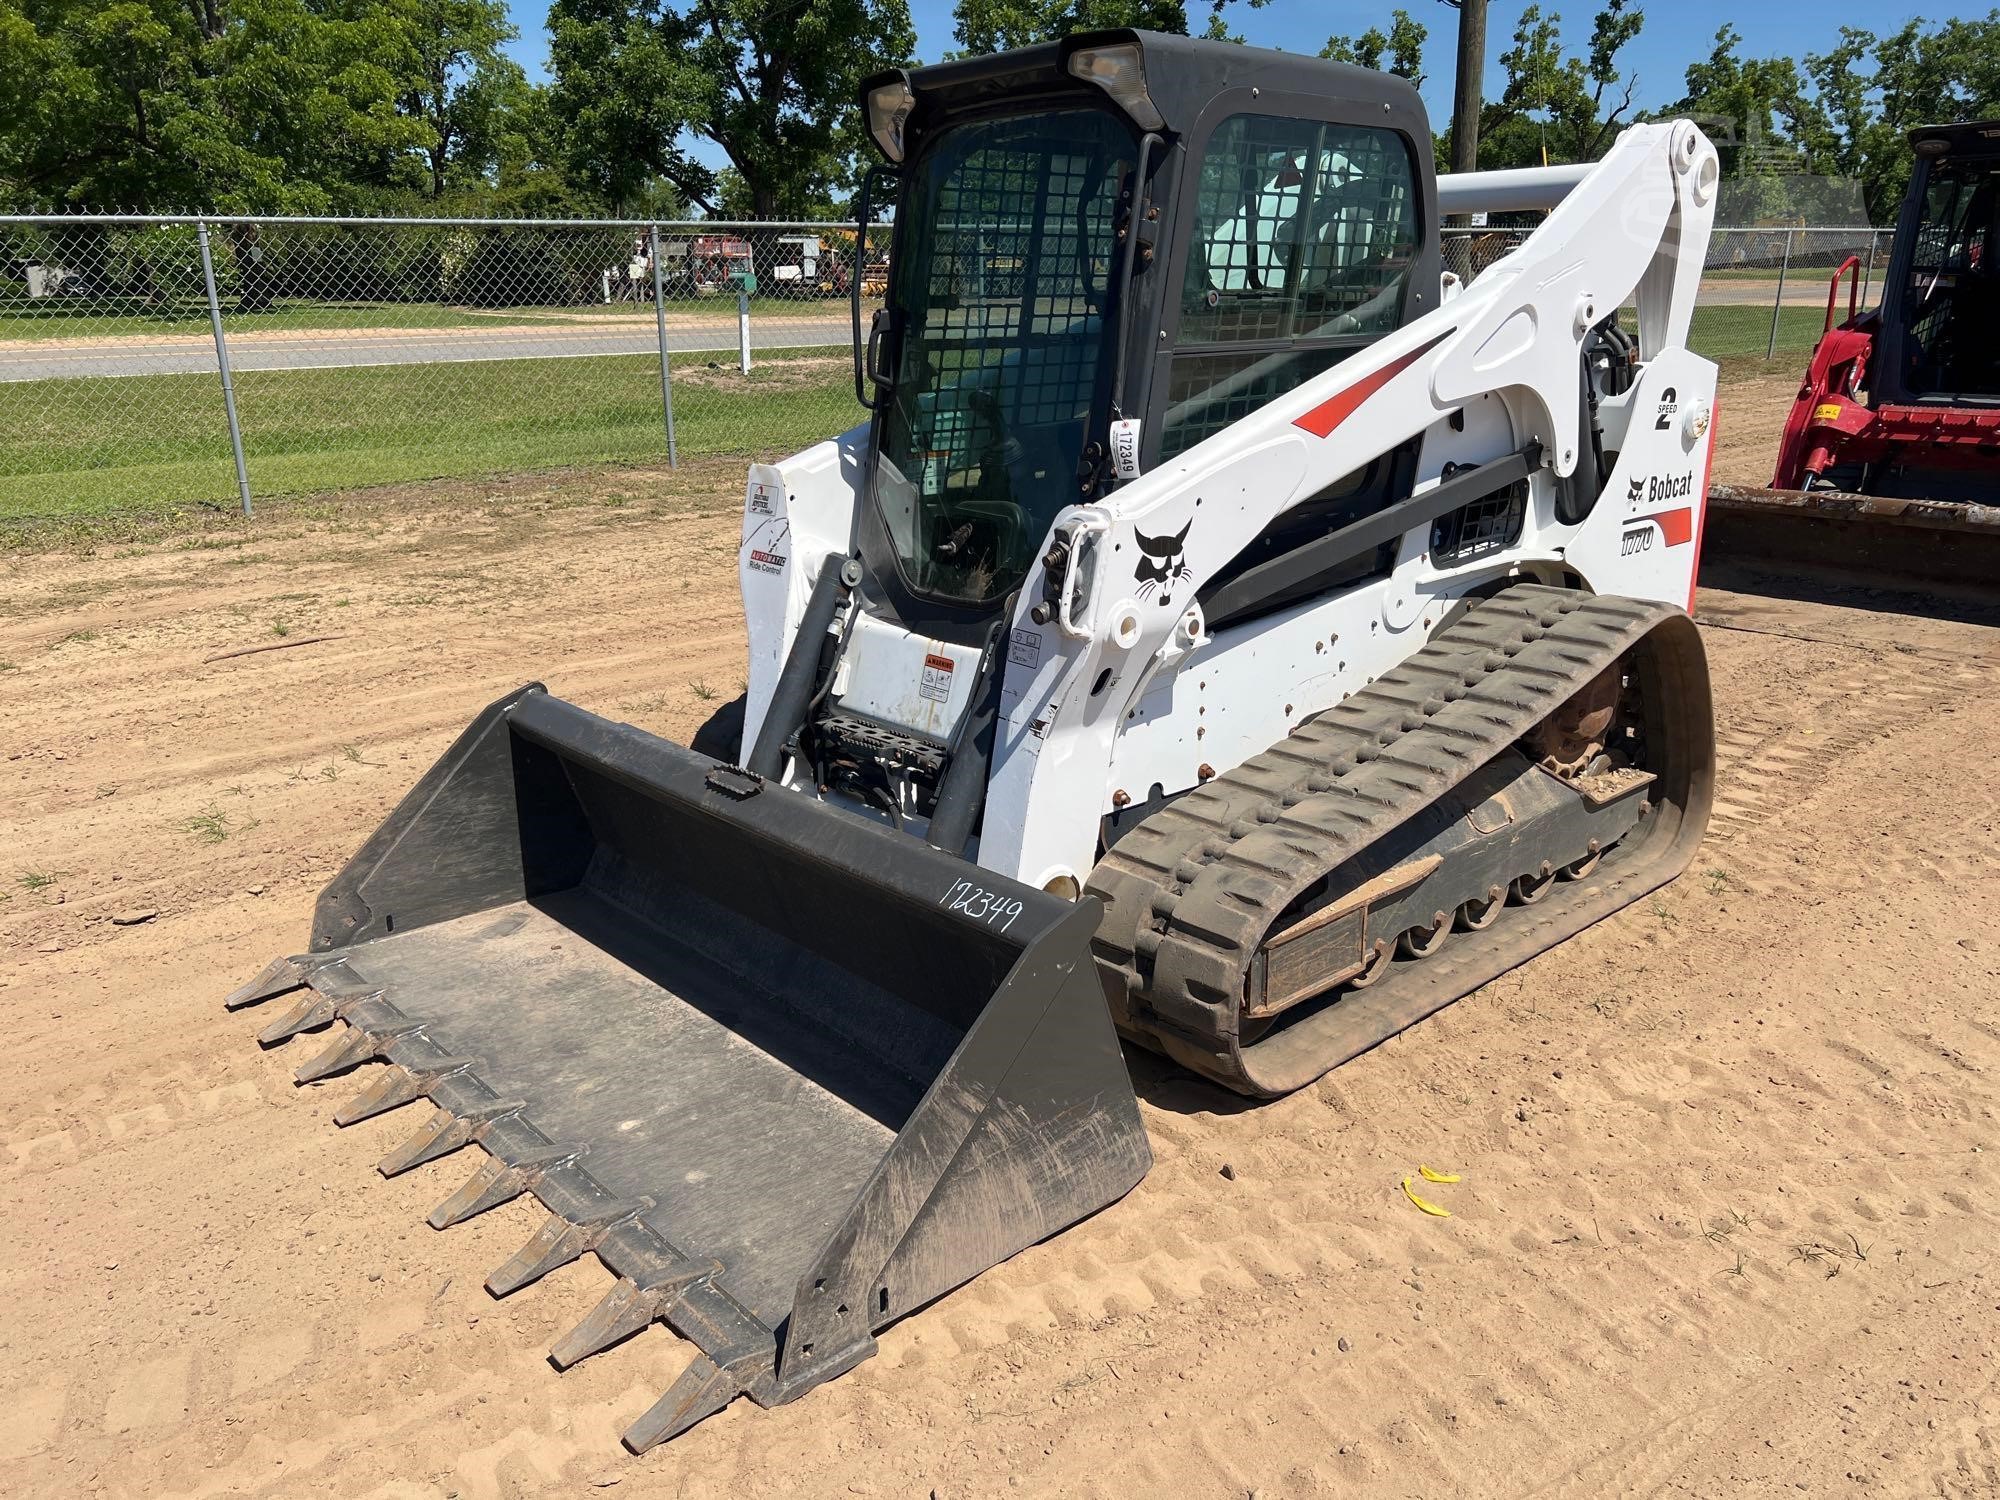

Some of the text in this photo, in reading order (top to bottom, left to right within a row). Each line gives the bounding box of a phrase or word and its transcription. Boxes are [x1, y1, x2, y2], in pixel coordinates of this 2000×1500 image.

[1655, 387, 1677, 430] 2
[1657, 404, 1678, 414] SPEED
[1119, 431, 1134, 472] 172349
[1648, 470, 1692, 503] Bobcat
[749, 560, 782, 576] Ride Control
[752, 551, 785, 566] AUTOMATIC
[939, 877, 1023, 933] 172349
